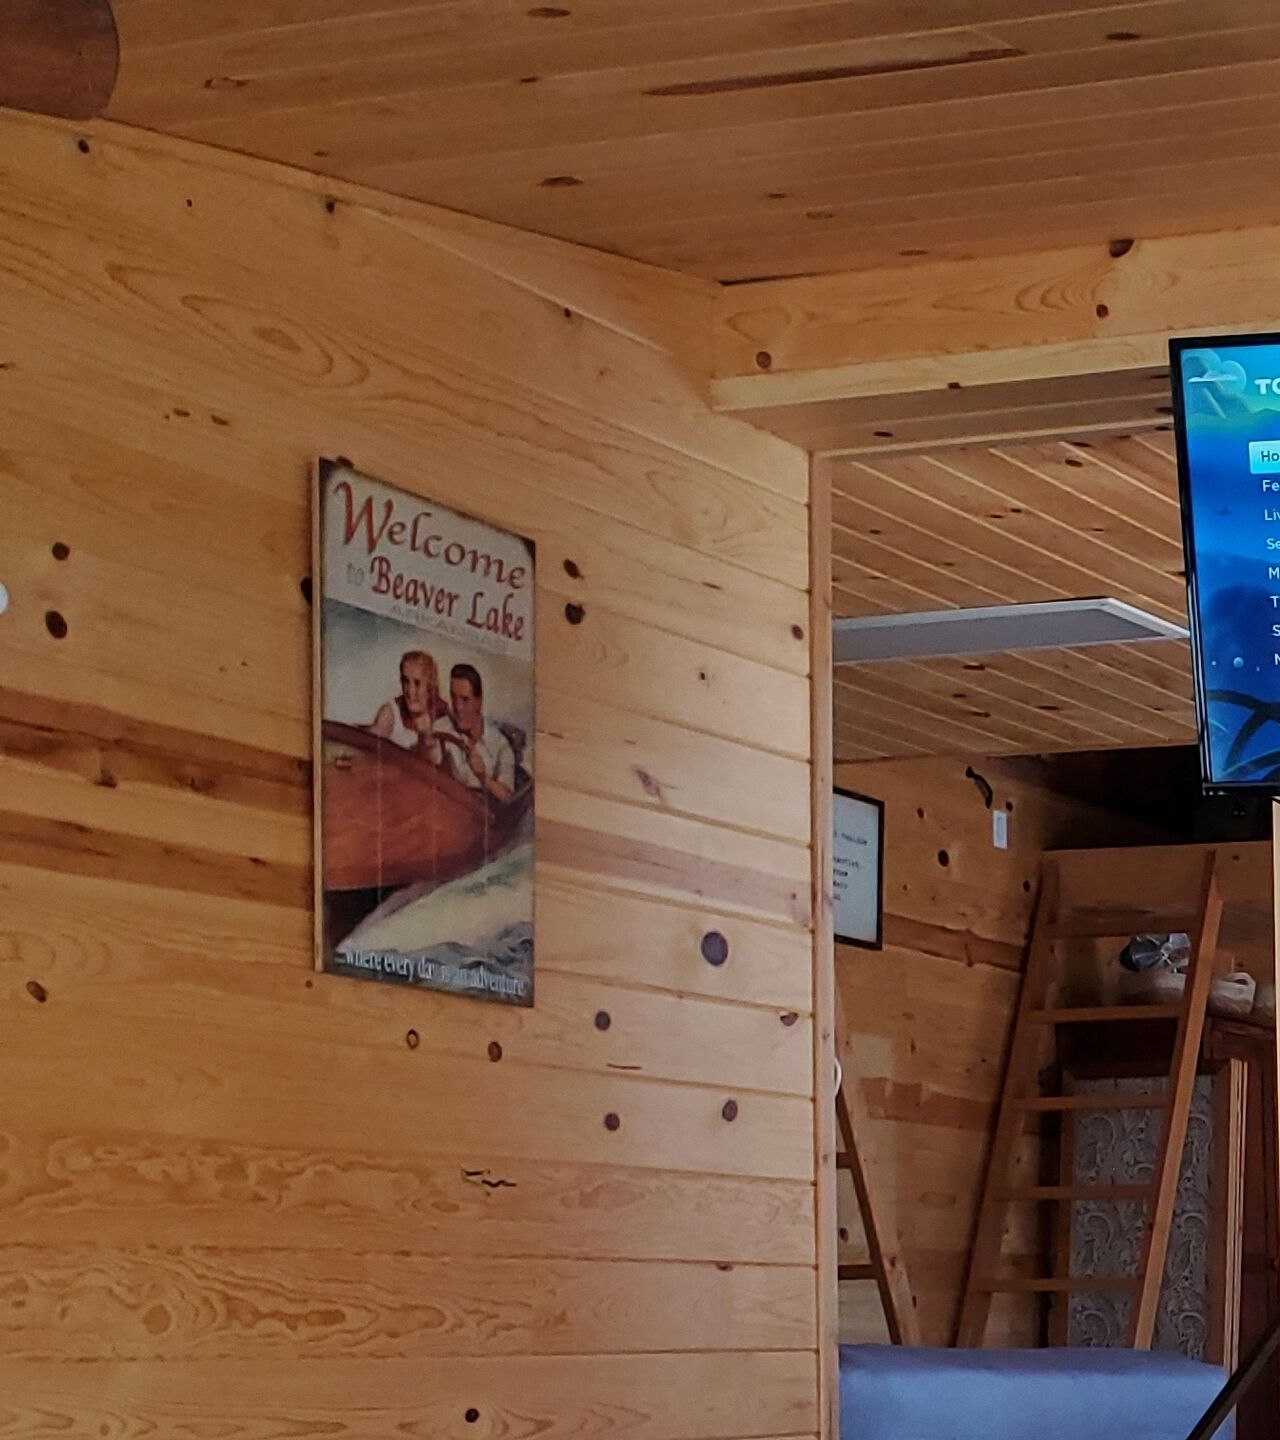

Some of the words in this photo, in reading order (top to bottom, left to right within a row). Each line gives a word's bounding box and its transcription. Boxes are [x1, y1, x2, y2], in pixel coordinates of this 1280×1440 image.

[333, 480, 526, 589] Welcome
[345, 562, 365, 586] to
[370, 556, 460, 617] Beaver
[465, 590, 525, 641] Lake
